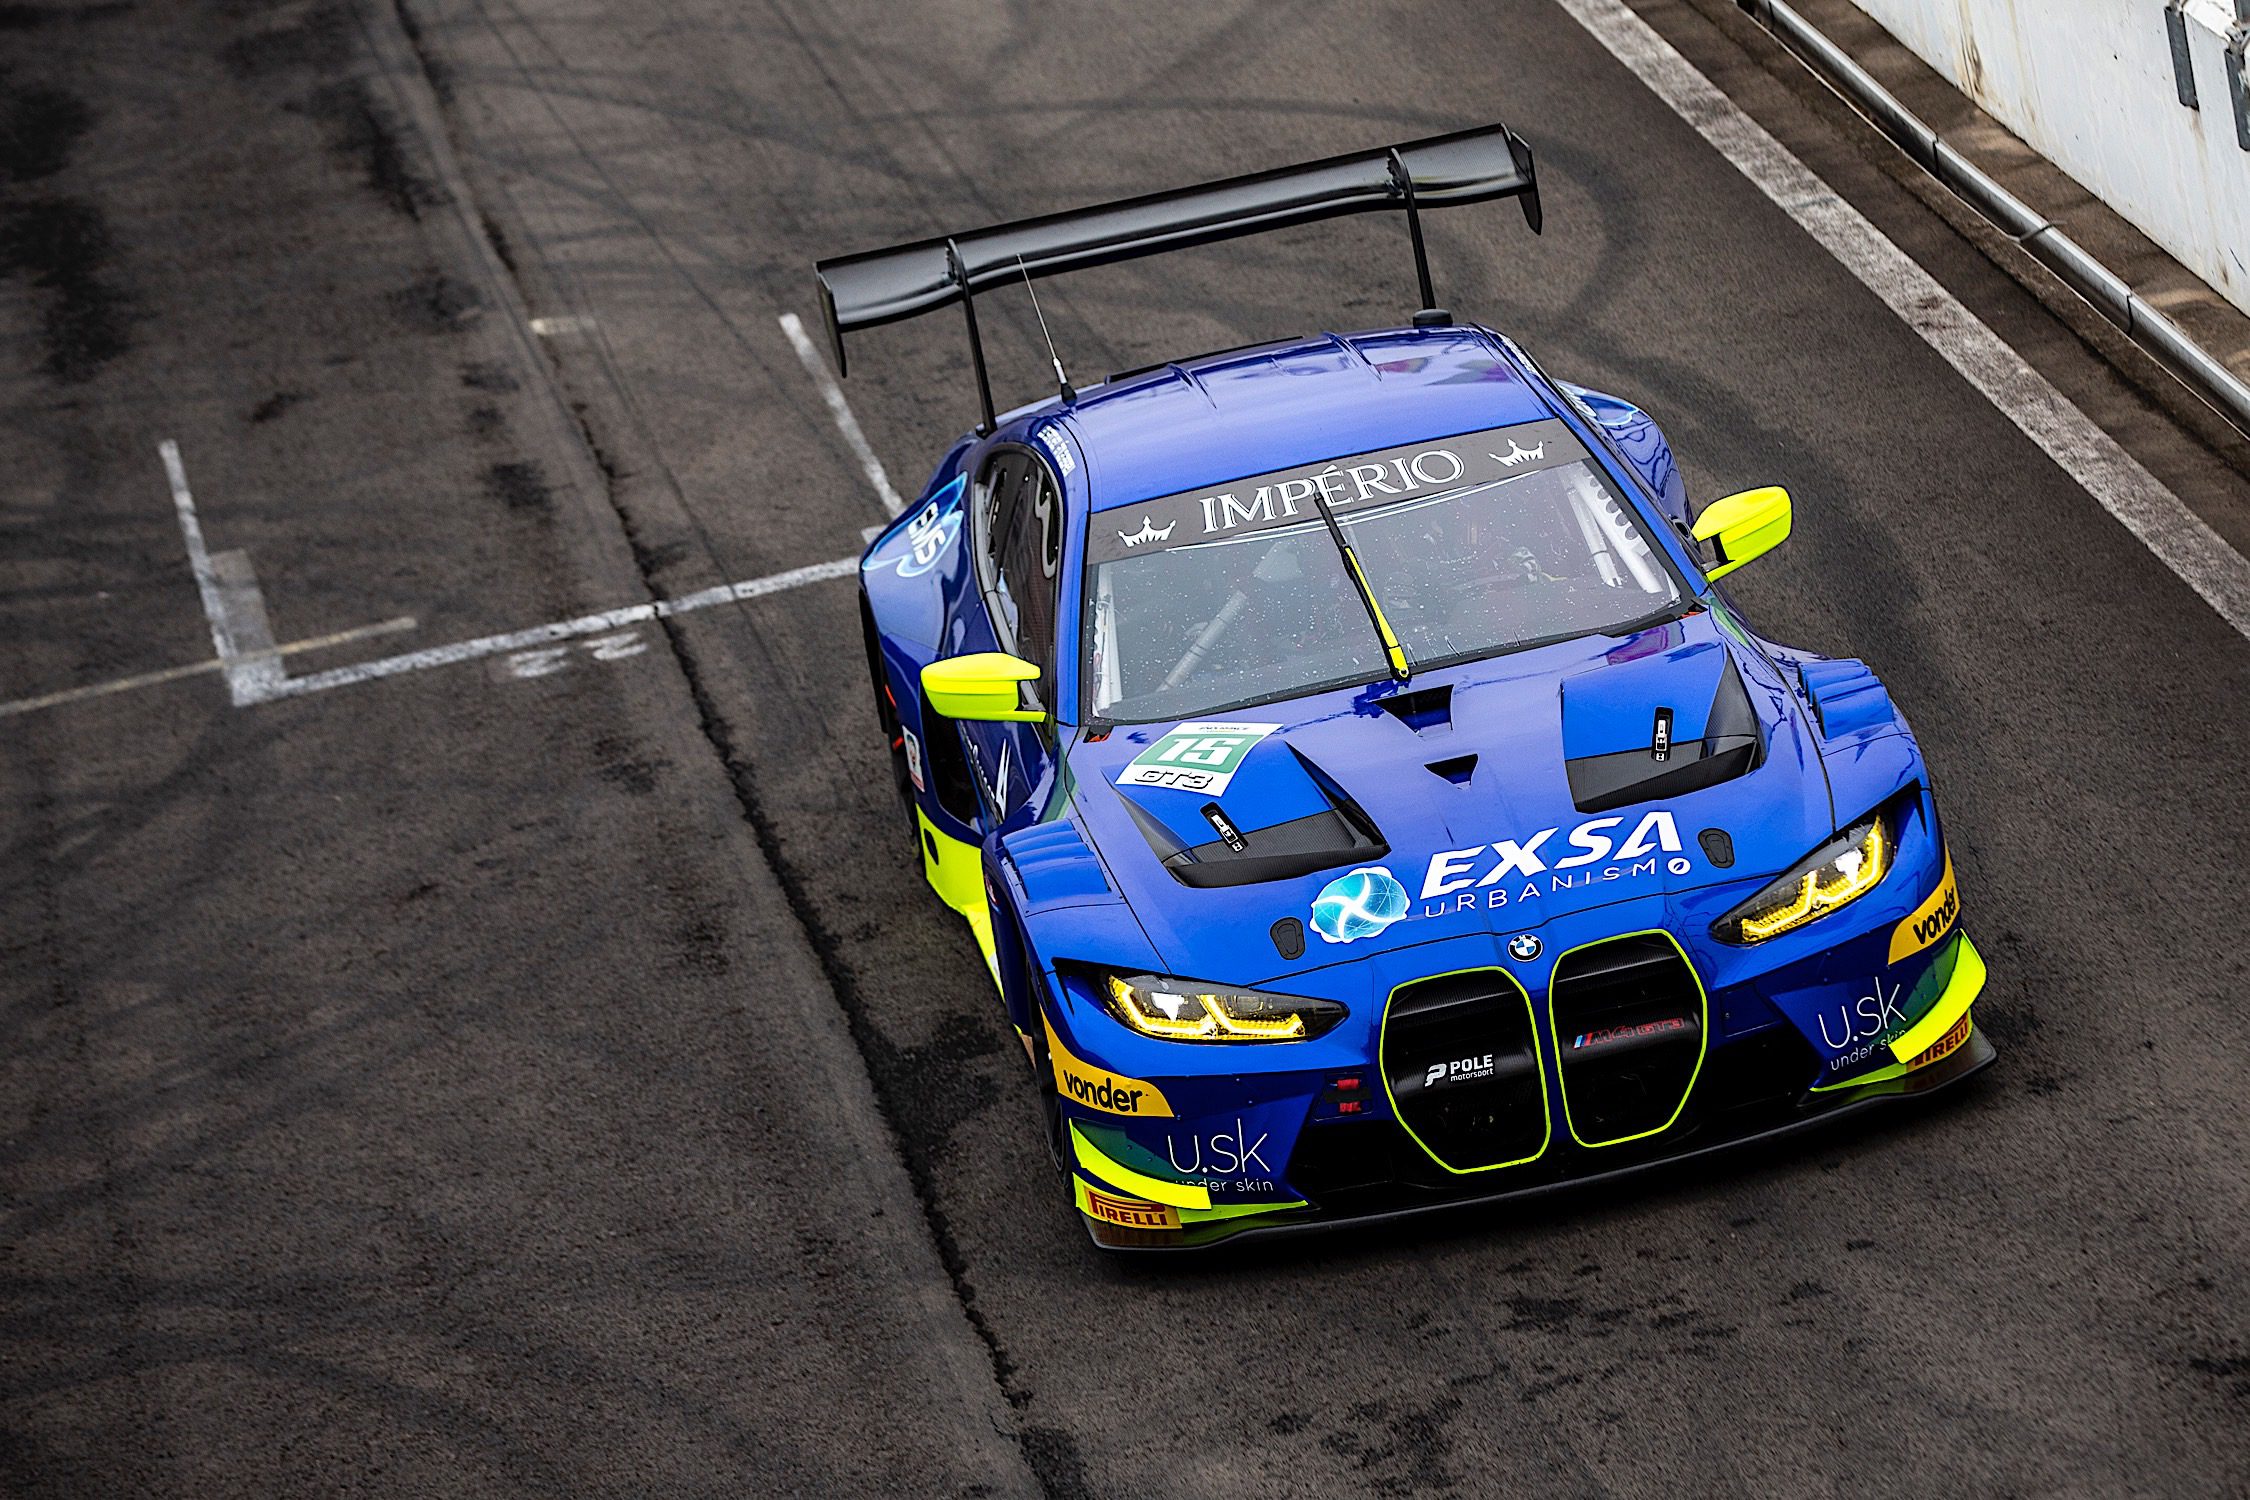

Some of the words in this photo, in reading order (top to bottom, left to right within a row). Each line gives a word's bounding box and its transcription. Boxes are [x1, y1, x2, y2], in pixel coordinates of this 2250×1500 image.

[1200, 449, 1465, 534] IMPÉRIO
[1156, 737, 1246, 766] 15
[1134, 769, 1214, 790] GT3
[1420, 811, 1683, 900] EXSA
[1912, 885, 1956, 944] vonder
[1450, 1054, 1493, 1075] POLE
[1830, 1043, 1875, 1071] under
[1450, 1067, 1493, 1082] motorsport
[1063, 1069, 1143, 1113] vonder
[1175, 1177, 1227, 1192] der
[1236, 1177, 1274, 1192] skin
[1089, 1191, 1168, 1226] PIRELLI
